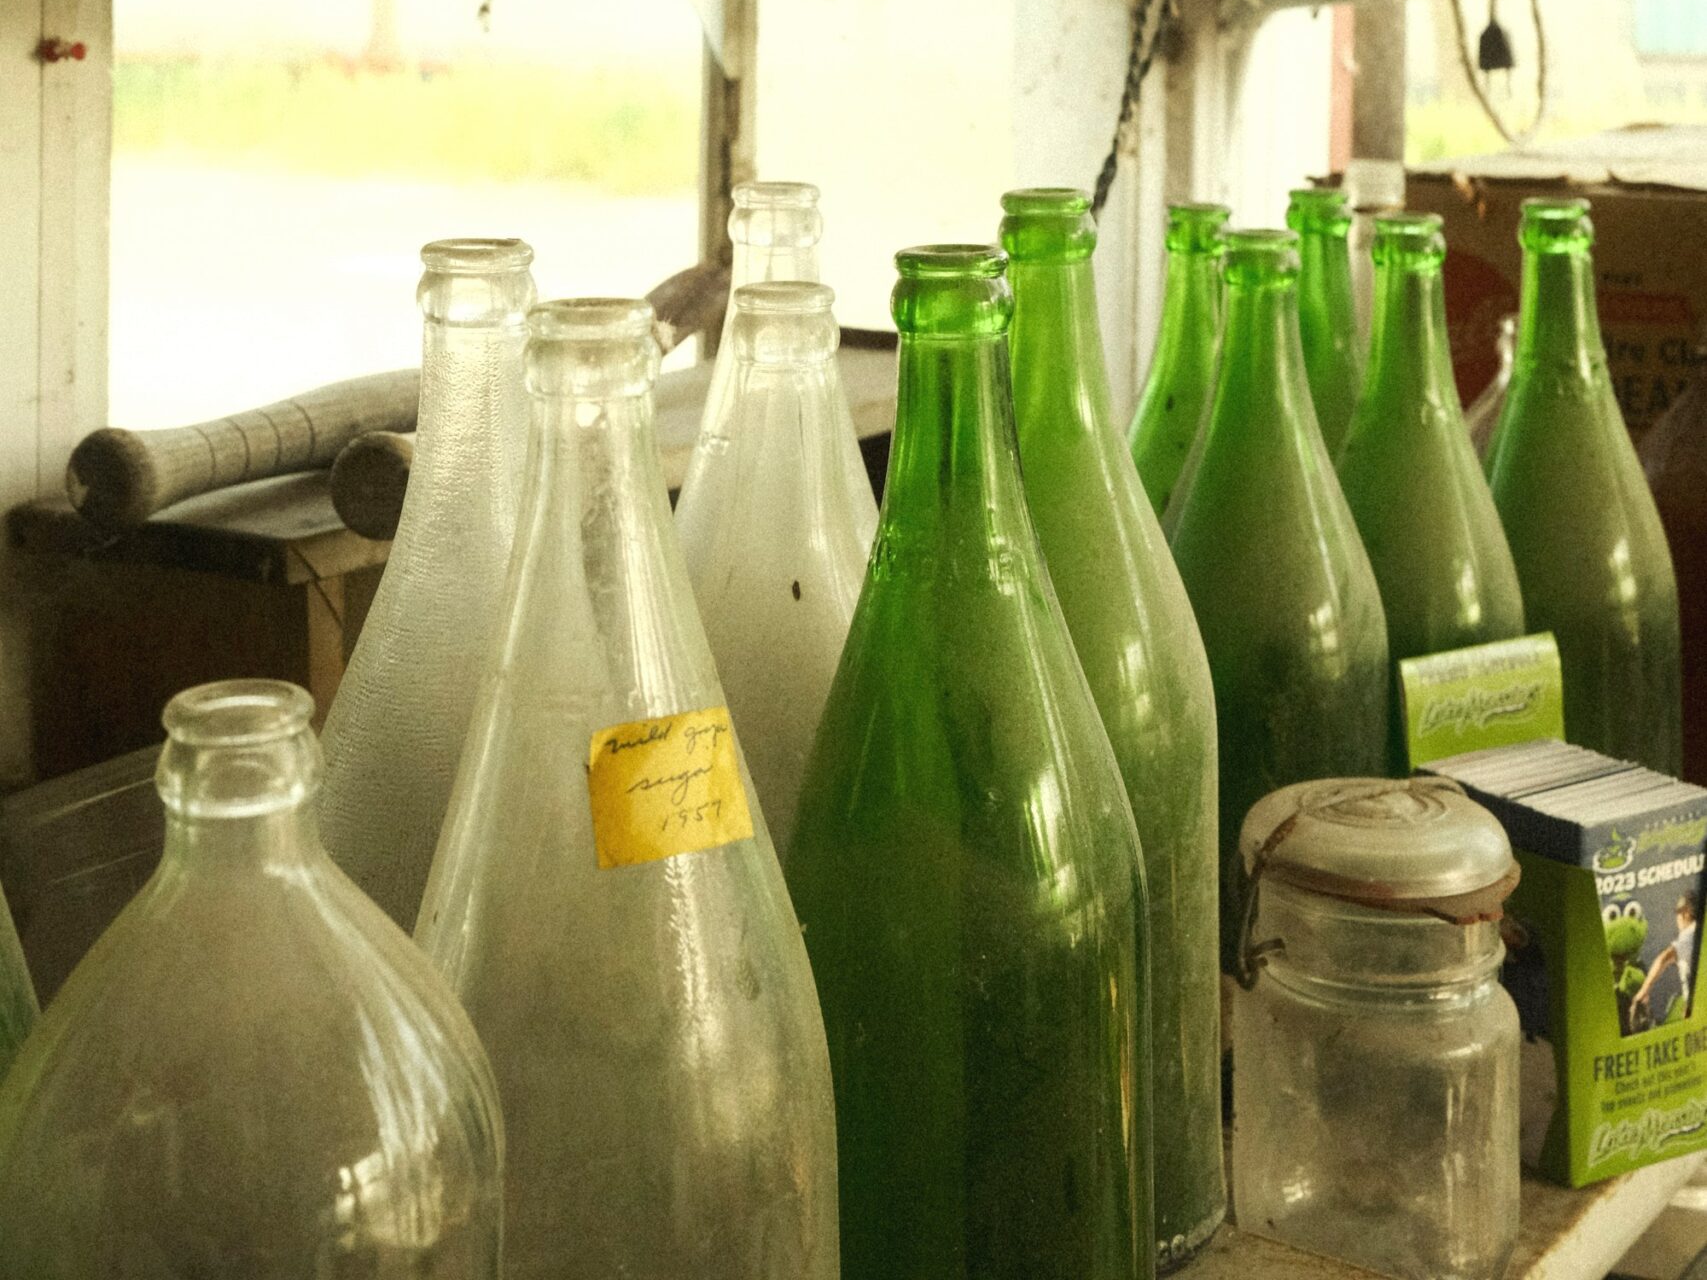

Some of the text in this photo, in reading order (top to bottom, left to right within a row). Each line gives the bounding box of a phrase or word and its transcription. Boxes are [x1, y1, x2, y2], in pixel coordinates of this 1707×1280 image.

[661, 799, 723, 832] 1957
[1596, 871, 1636, 895] 2023
[1592, 1050, 1640, 1082] FREE!
[1644, 1036, 1680, 1070] TAKE
